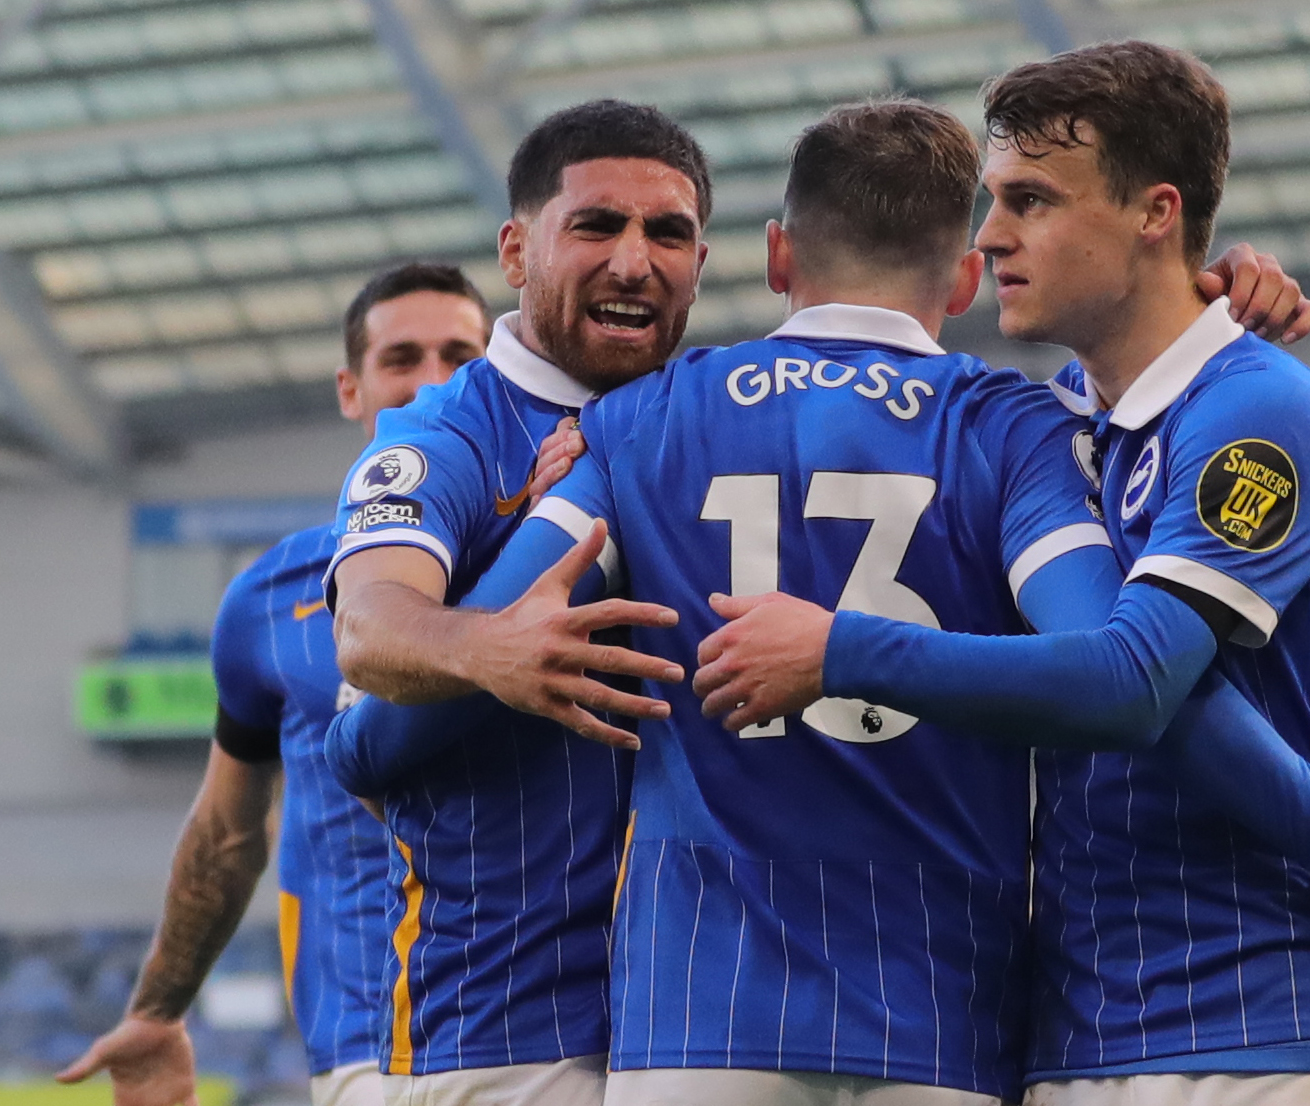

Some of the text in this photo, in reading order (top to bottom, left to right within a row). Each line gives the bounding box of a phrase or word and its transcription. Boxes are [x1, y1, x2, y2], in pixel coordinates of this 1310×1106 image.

[726, 357, 935, 420] GROSS
[1223, 447, 1292, 498] SNICKERS
[363, 503, 413, 518] room
[363, 512, 421, 531] racism
[1227, 483, 1269, 522] UK
[699, 470, 942, 744] 13
